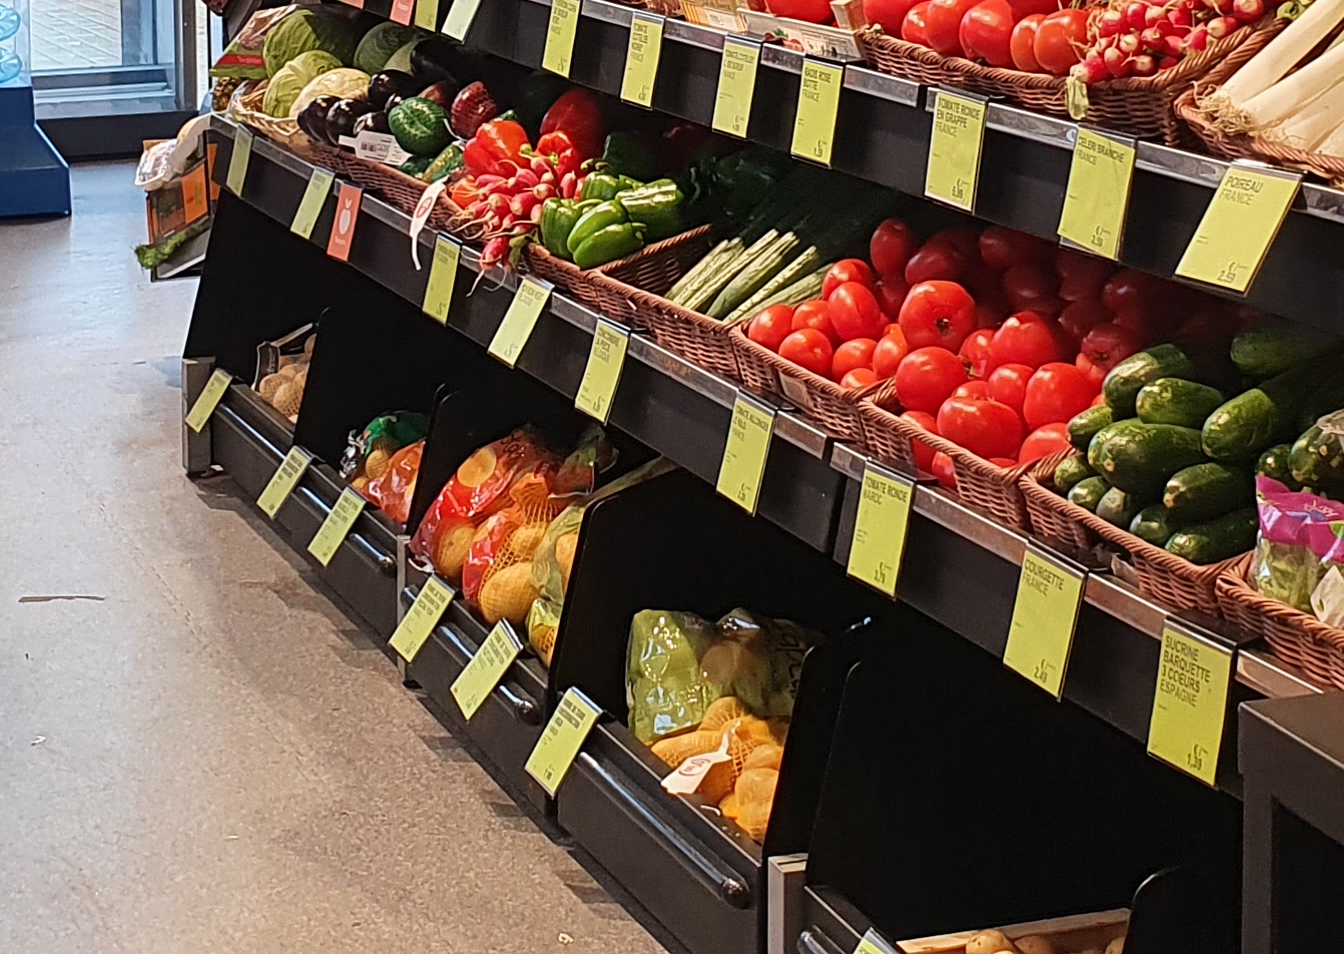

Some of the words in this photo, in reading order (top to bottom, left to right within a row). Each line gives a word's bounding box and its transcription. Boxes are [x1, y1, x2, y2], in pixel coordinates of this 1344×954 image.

[1218, 188, 1253, 206] FRANCE
[1224, 175, 1264, 194] POIREAU
[1022, 574, 1049, 597] FRANCE
[1024, 558, 1065, 591] COURGETTE
[1165, 635, 1199, 662] SUCRINE
[1163, 649, 1211, 683] BARQUETTE
[1167, 666, 1201, 693] COEURS
[1160, 680, 1198, 707] ESPAGNE
